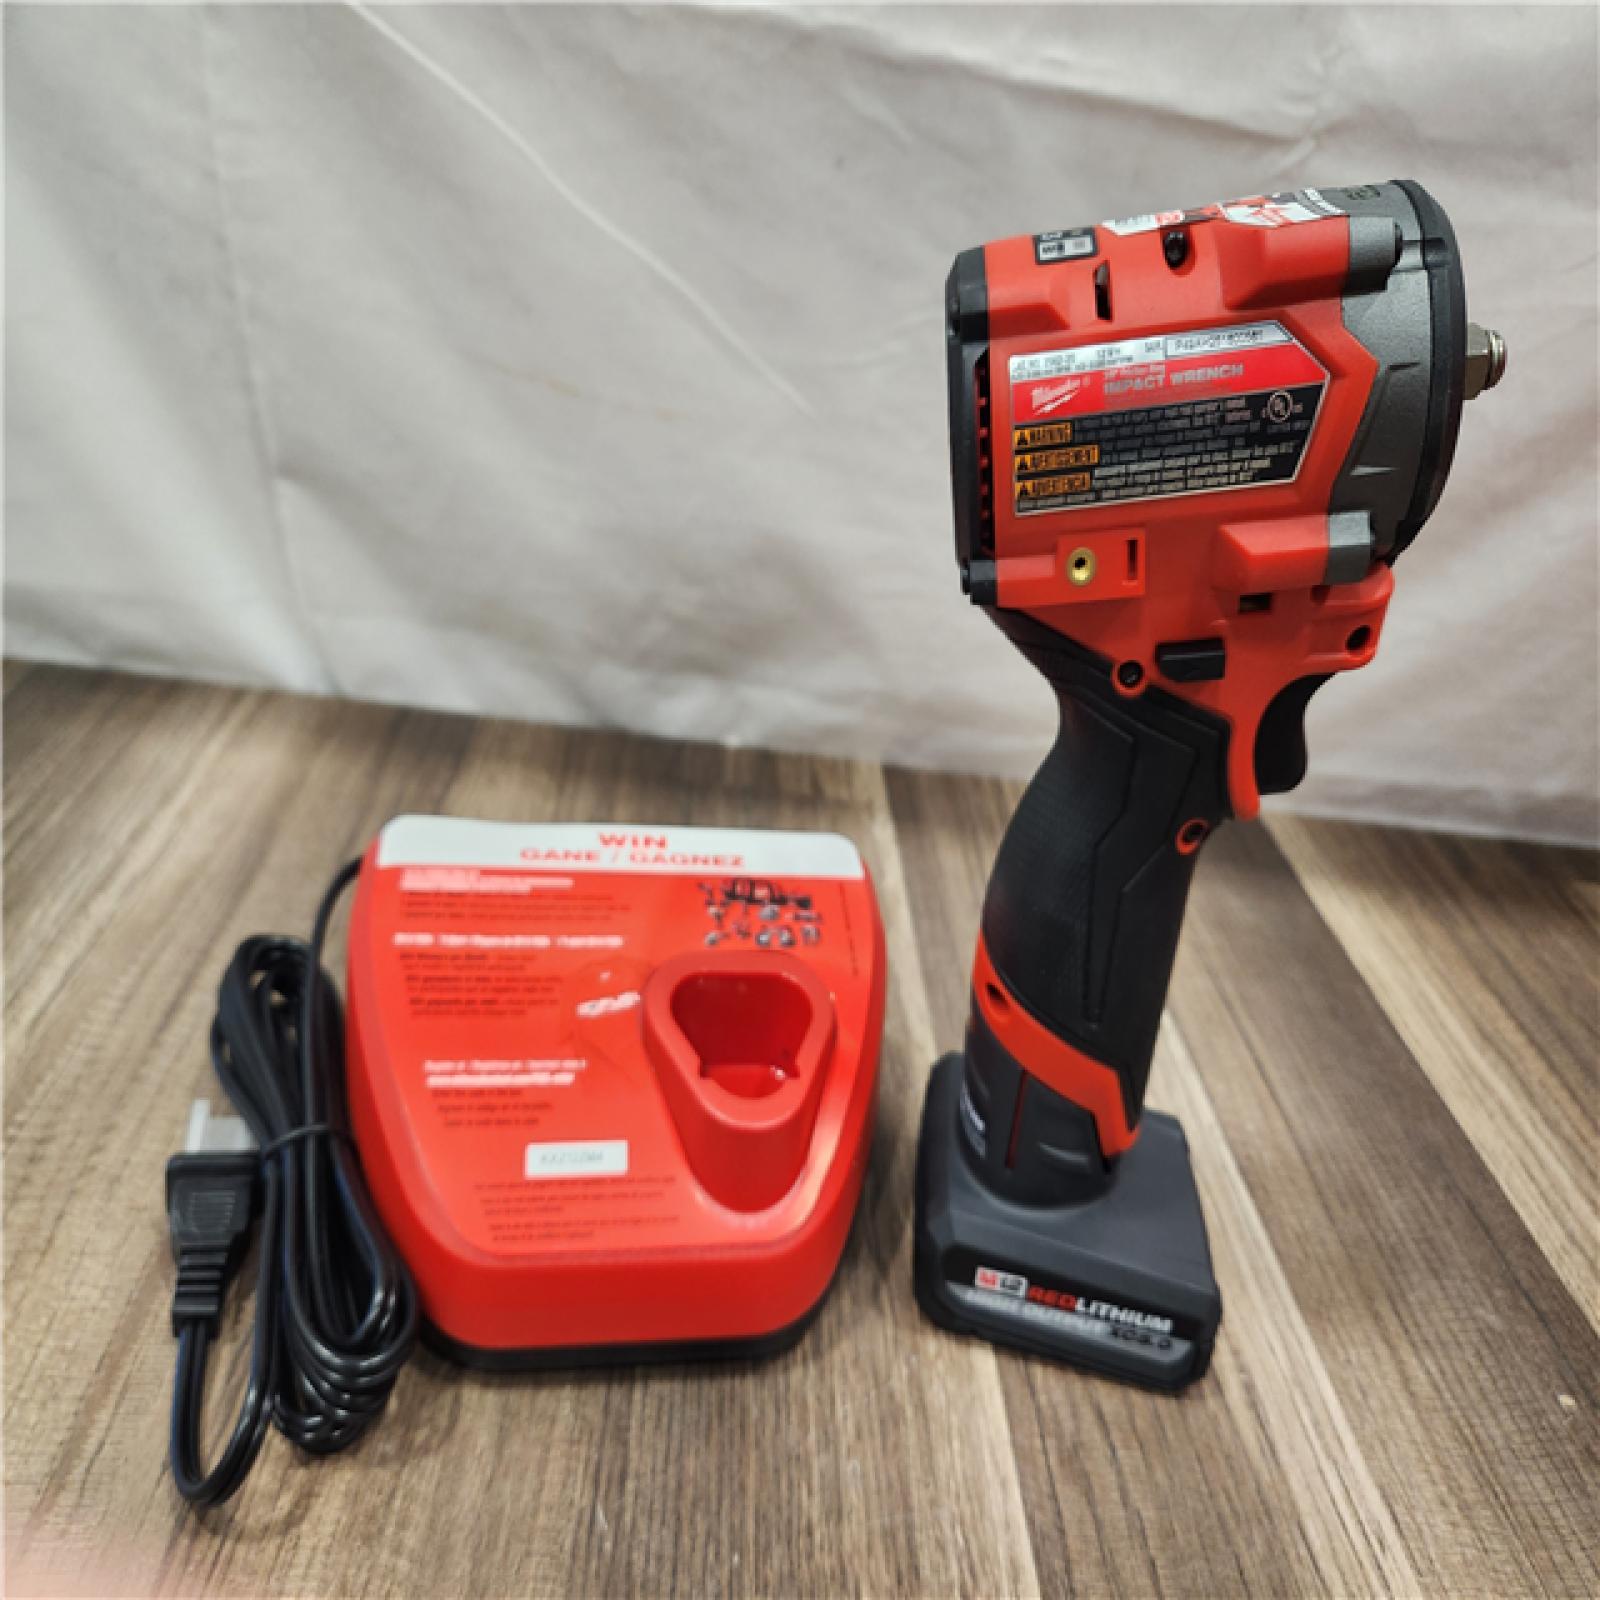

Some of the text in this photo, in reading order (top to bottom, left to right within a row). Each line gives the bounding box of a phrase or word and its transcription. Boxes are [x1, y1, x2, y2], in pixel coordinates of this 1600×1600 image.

[1170, 363, 1244, 385] WRENCH
[599, 833, 669, 849] WIN
[520, 847, 599, 862] GANE
